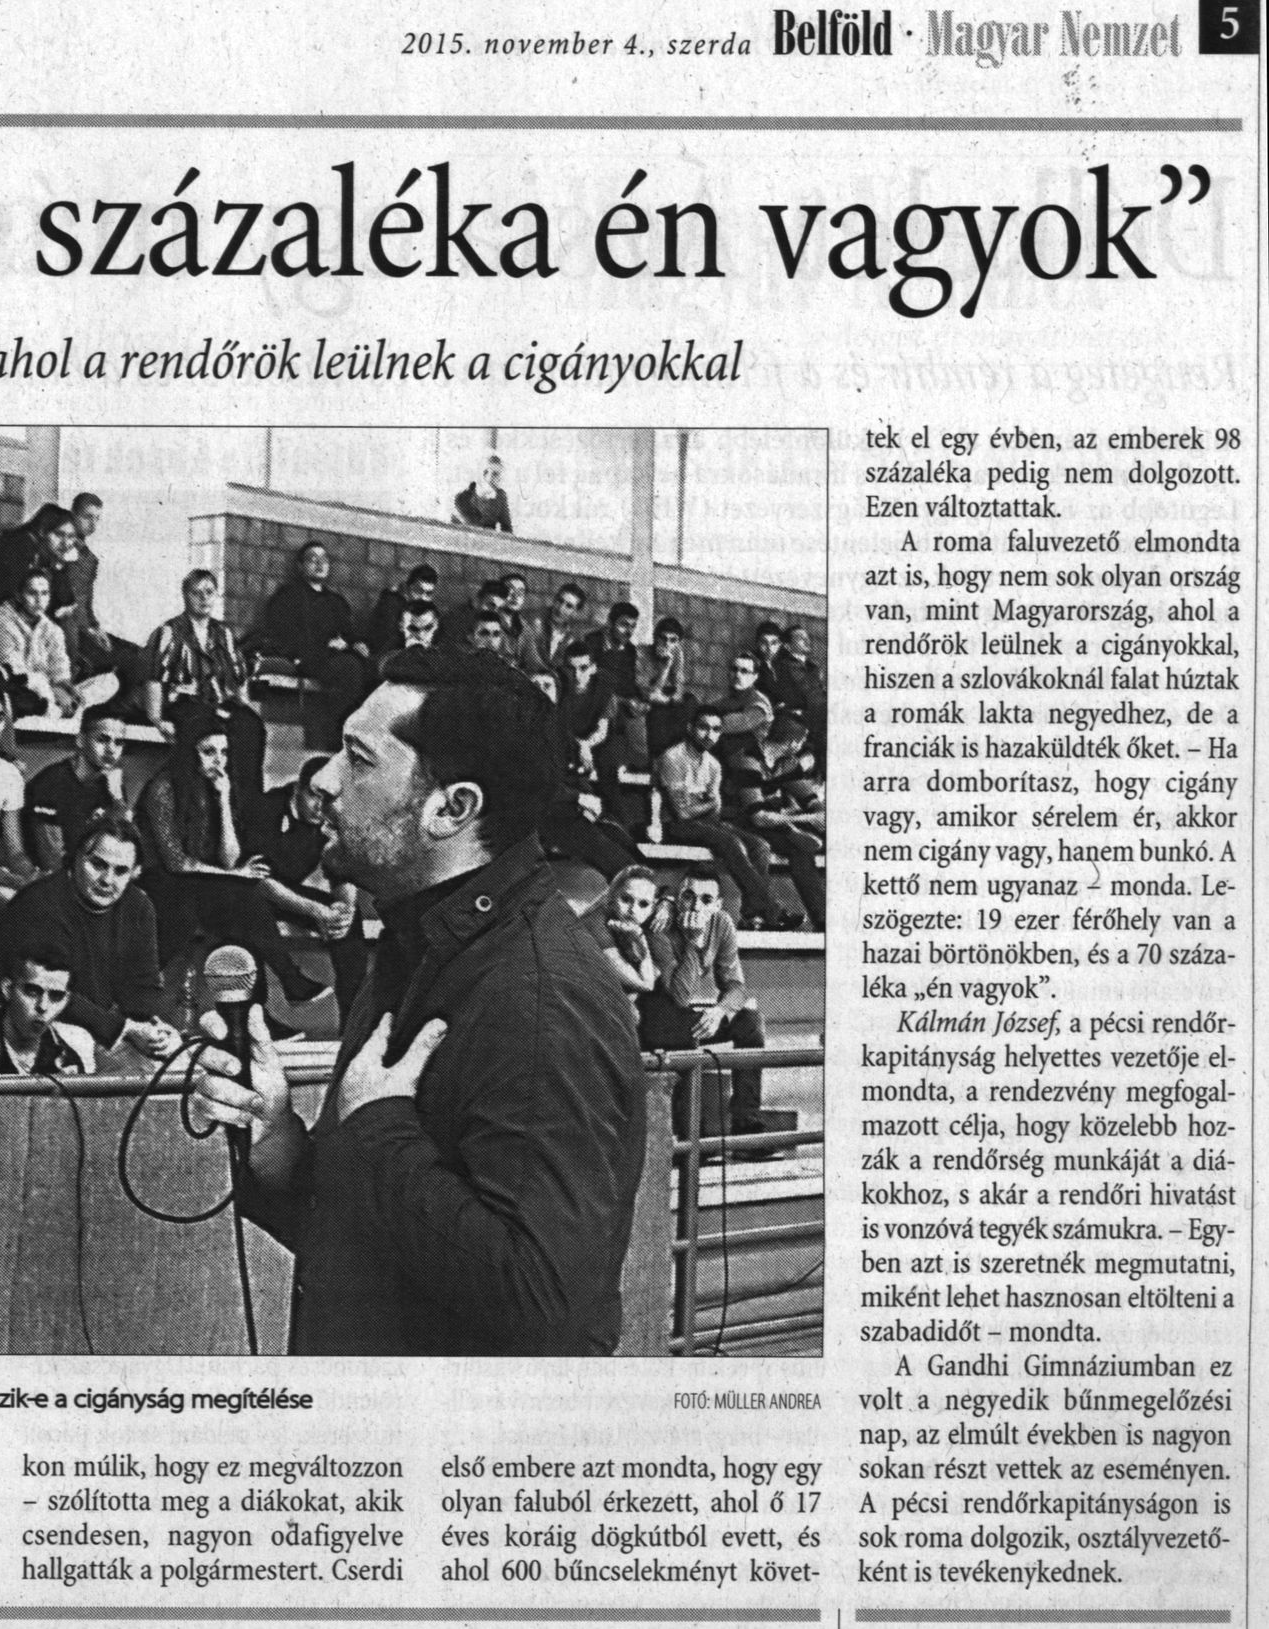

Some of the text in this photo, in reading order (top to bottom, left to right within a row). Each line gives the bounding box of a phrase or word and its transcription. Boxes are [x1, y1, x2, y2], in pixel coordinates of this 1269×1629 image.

[773, 9, 1180, 69] Belföld Magyar Nemzet
[1220, 8, 1241, 40] 5
[400, 30, 752, 59] 2015. november 4., szerda
[36, 160, 560, 279] százaléka
[594, 168, 726, 279] én
[758, 163, 1211, 319] vagyok”
[83, 351, 106, 379] a
[121, 337, 301, 380] rendőrök
[313, 337, 456, 381] leülnek
[468, 352, 491, 381] a
[504, 339, 744, 395] cigányokkal
[865, 494, 1062, 518] Ezen változtattak.
[865, 597, 1240, 629] van, mint Magyarország, ahol a
[863, 768, 1238, 801] arra domborítasz, hogy cigány
[861, 1043, 1236, 1075] kapitányság helyettes vezetője el-
[54, 1392, 68, 1409] a
[73, 1386, 185, 1414] cigányság
[191, 1387, 314, 1415] megítélése
[673, 1388, 823, 1411] FOTÓ: MÜLLER ANDREA
[858, 1386, 1232, 1419] volt a negyedik bűnmegelőzési
[22, 1453, 403, 1485] kon múlik, hogy ez megváltozzon
[441, 1454, 823, 1486] első embere azt mondta, hogy egy
[22, 1521, 404, 1554] csendesen, nagyon odafigyelve
[441, 1557, 820, 1589] ahol 600 bűncselekményt követ-
[857, 1558, 1123, 1590] ként is tevékenykednek.
